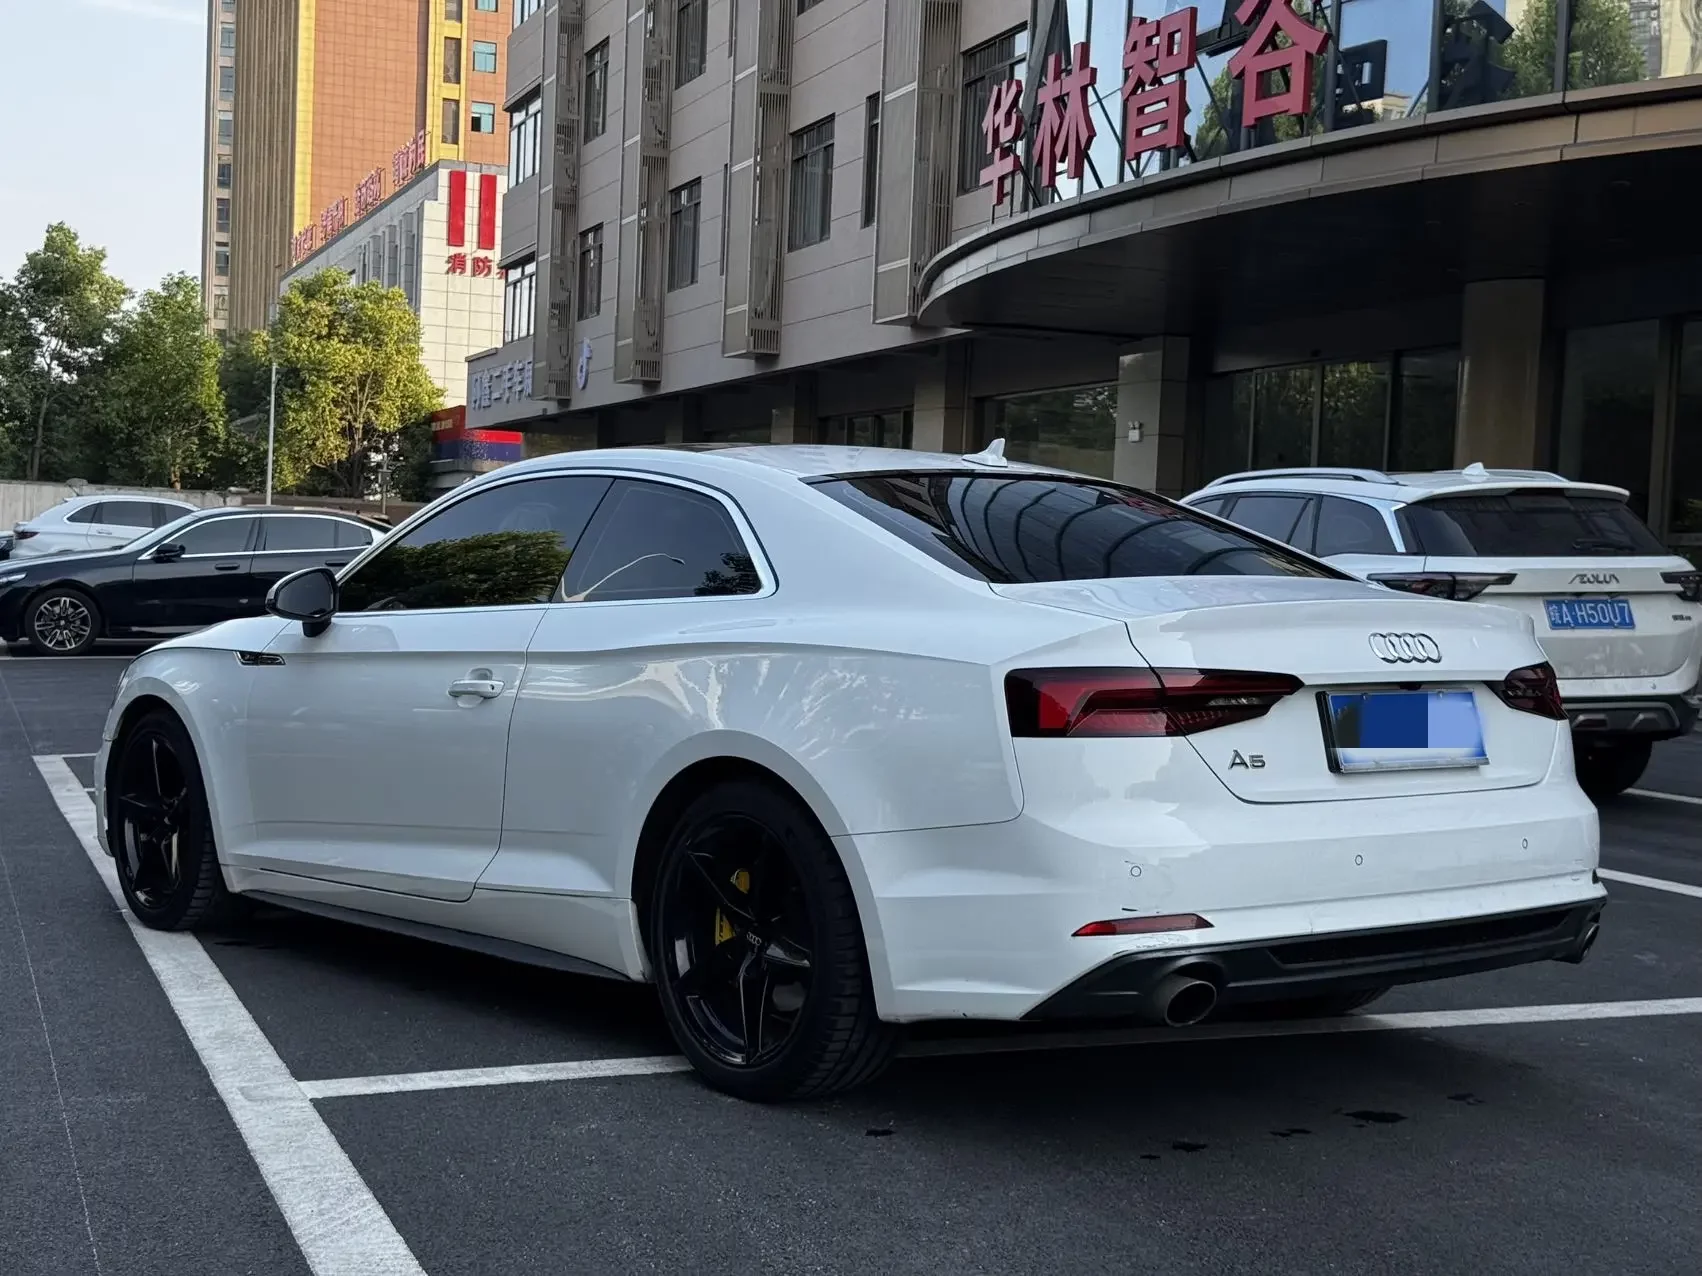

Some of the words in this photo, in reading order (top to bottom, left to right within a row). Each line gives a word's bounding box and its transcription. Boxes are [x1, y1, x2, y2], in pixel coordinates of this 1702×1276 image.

[979, 0, 1330, 206] 华林智谷
[445, 252, 508, 280] 消防
[1228, 749, 1267, 770] A5
